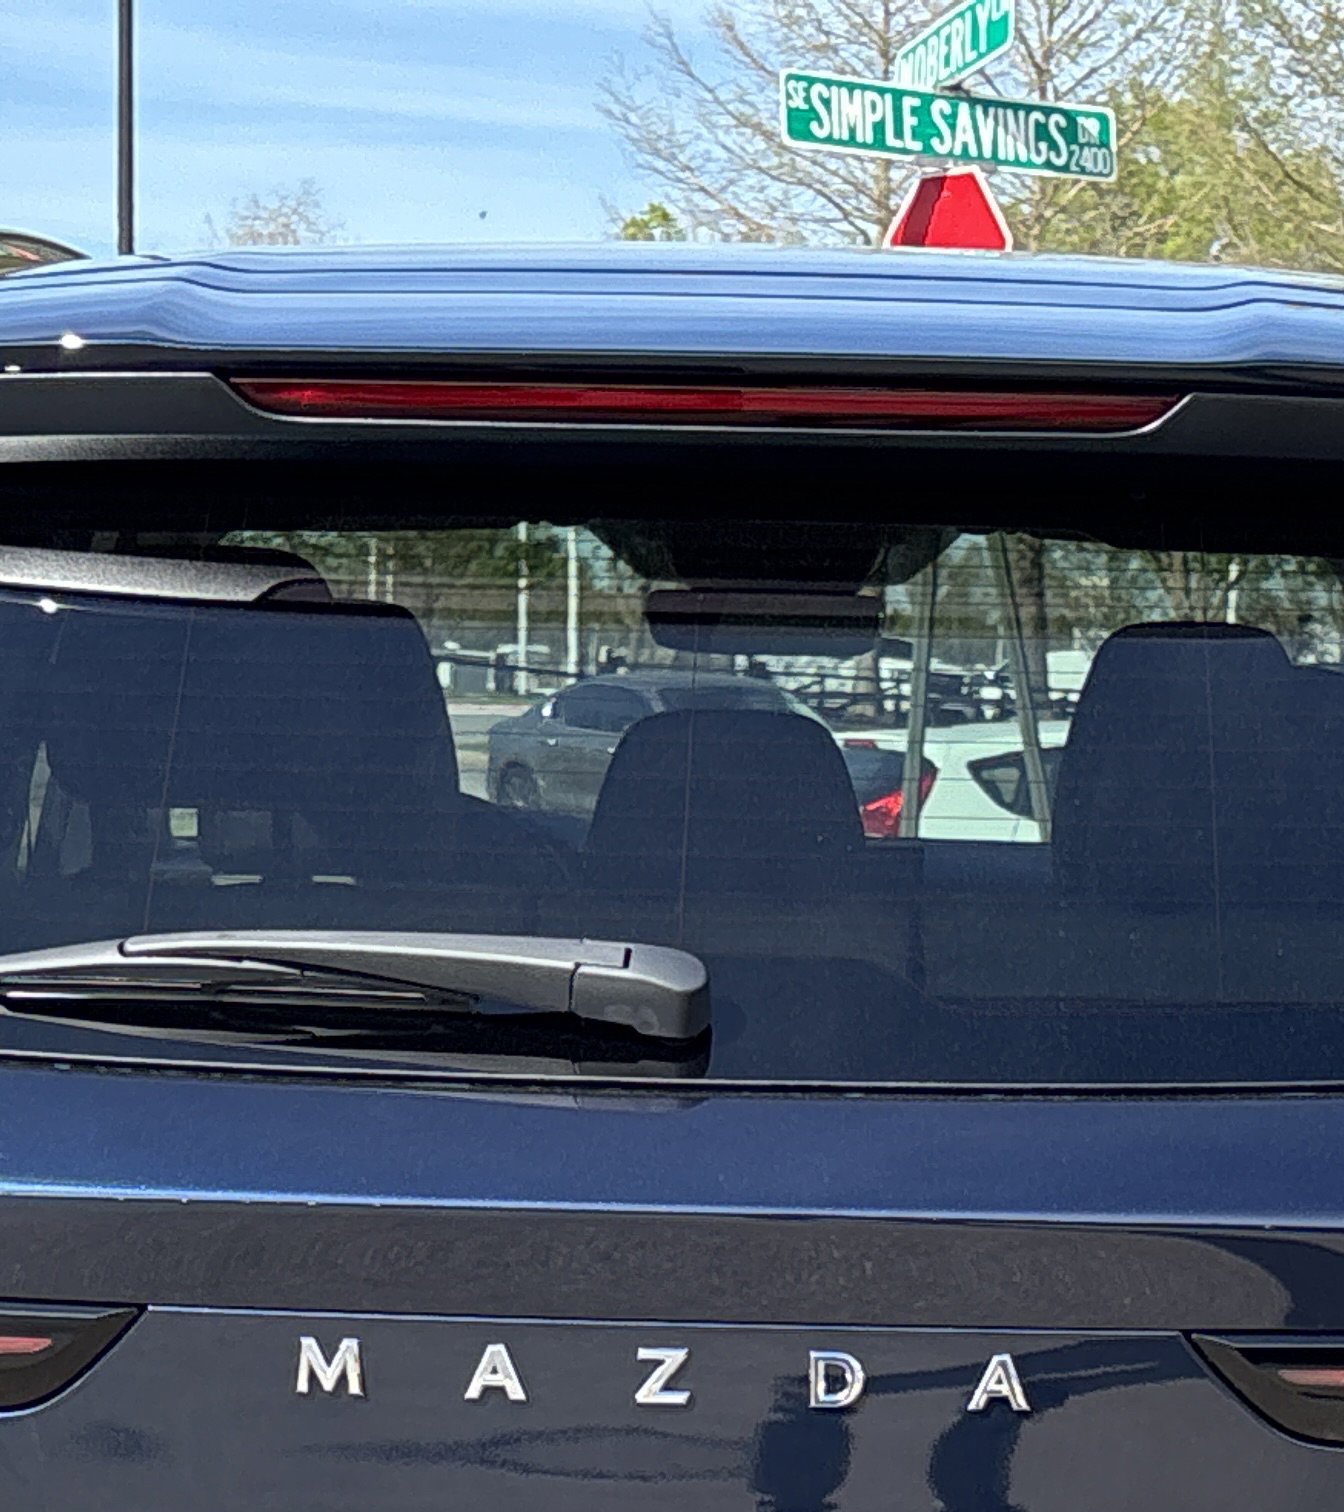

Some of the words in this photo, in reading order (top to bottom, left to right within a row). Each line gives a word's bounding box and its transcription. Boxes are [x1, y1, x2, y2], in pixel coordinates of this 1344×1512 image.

[899, 0, 989, 86] MOBERLY
[787, 80, 809, 110] SE
[809, 83, 923, 151] SIMPLE
[930, 99, 1068, 167] SAVINGS
[1077, 117, 1101, 145] DR
[1069, 144, 1111, 174] 2400
[296, 1336, 1030, 1413] MAZDA
